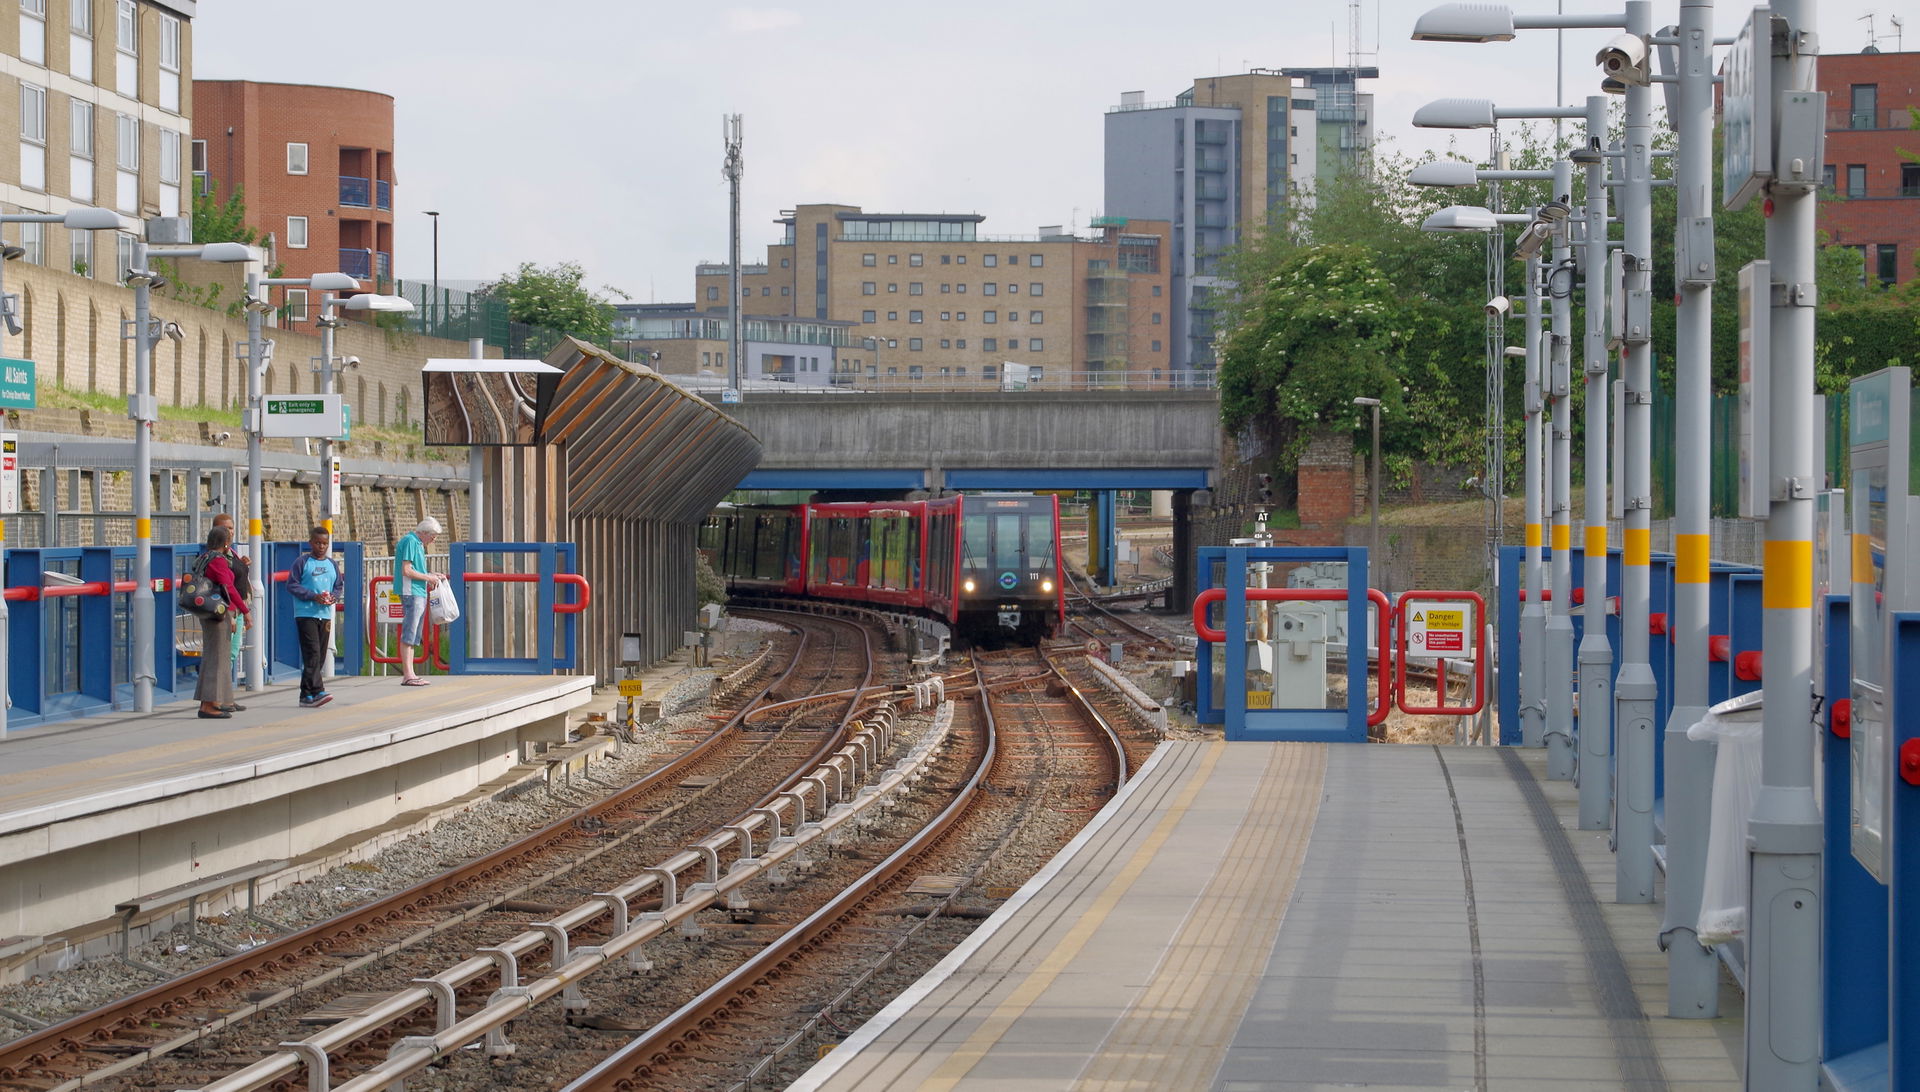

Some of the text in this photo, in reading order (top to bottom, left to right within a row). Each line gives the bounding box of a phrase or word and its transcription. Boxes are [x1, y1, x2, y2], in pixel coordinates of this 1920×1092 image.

[5, 366, 28, 385] All Saints
[1258, 513, 1269, 521] AT
[1030, 572, 1039, 580] 111
[1429, 613, 1454, 621] Danger
